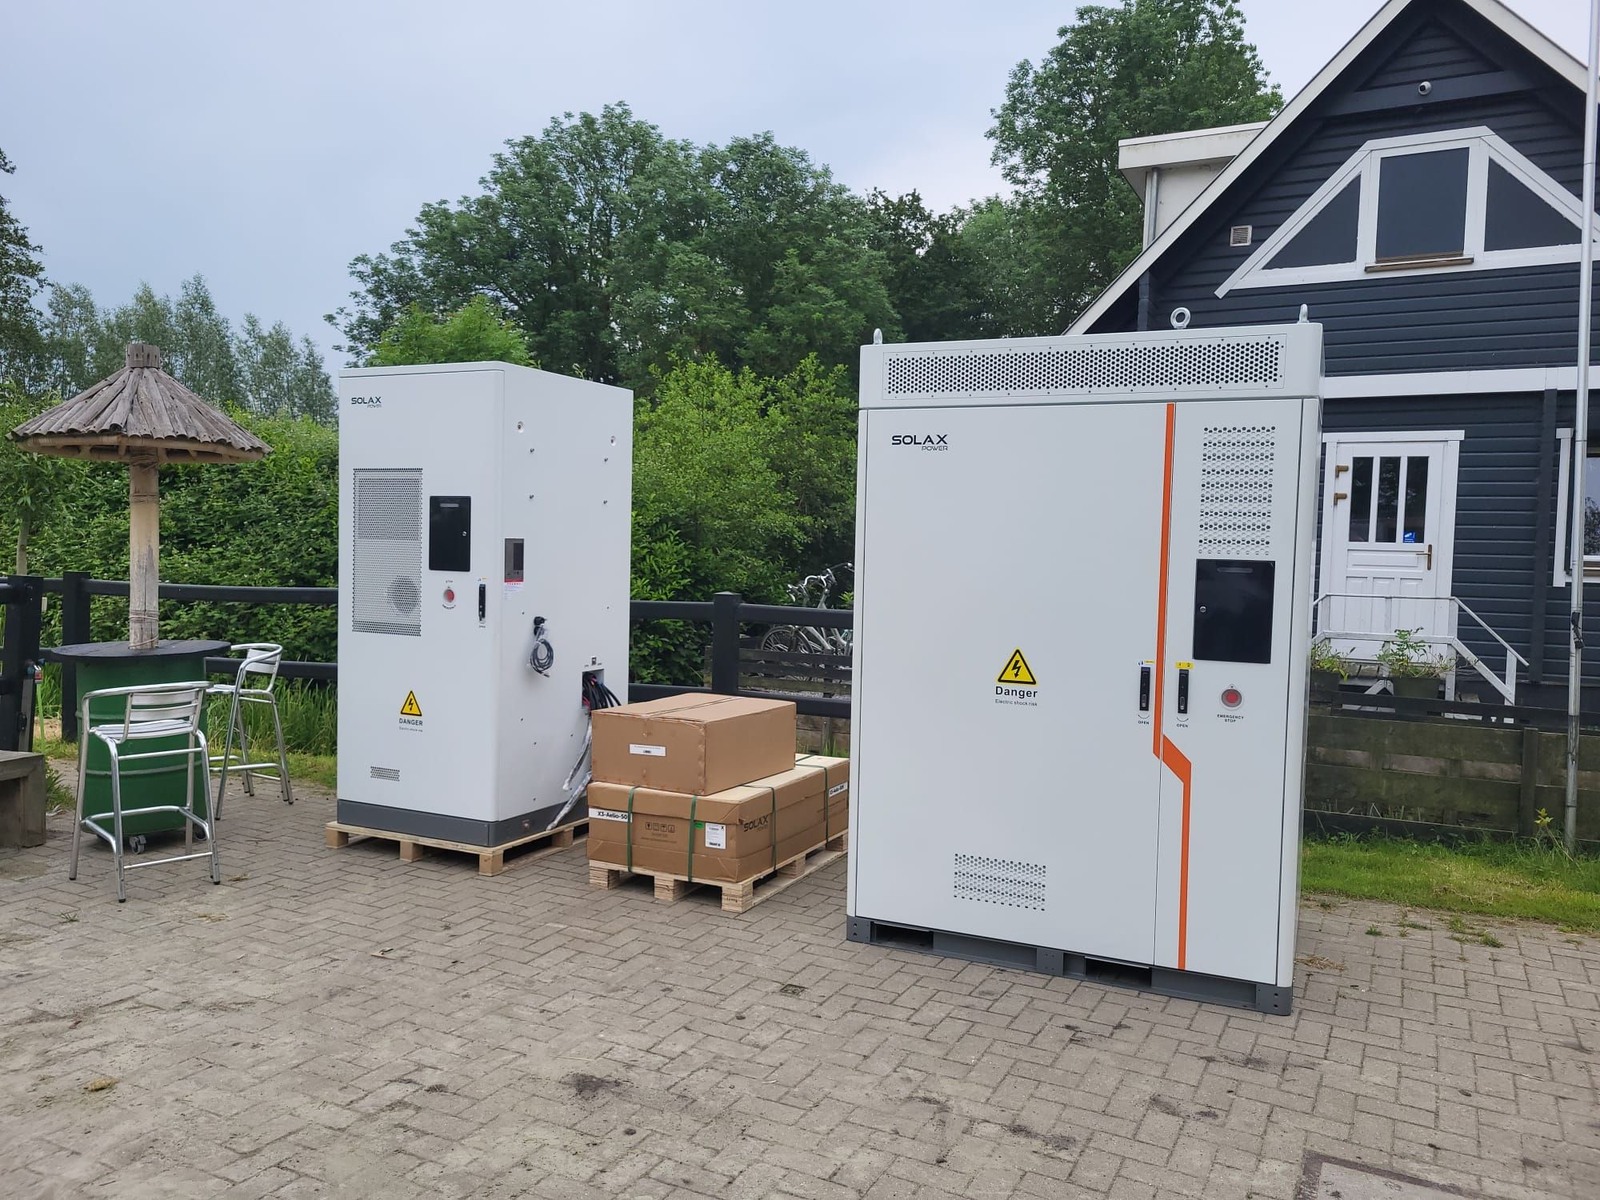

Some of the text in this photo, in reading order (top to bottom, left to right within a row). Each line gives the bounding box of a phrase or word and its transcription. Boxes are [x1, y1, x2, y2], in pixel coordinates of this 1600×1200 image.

[351, 396, 382, 405] SOLAX
[891, 434, 948, 446] SOLAX
[995, 685, 1038, 700] Danger
[399, 717, 424, 726] DANGER
[743, 815, 769, 833] SOLAX
